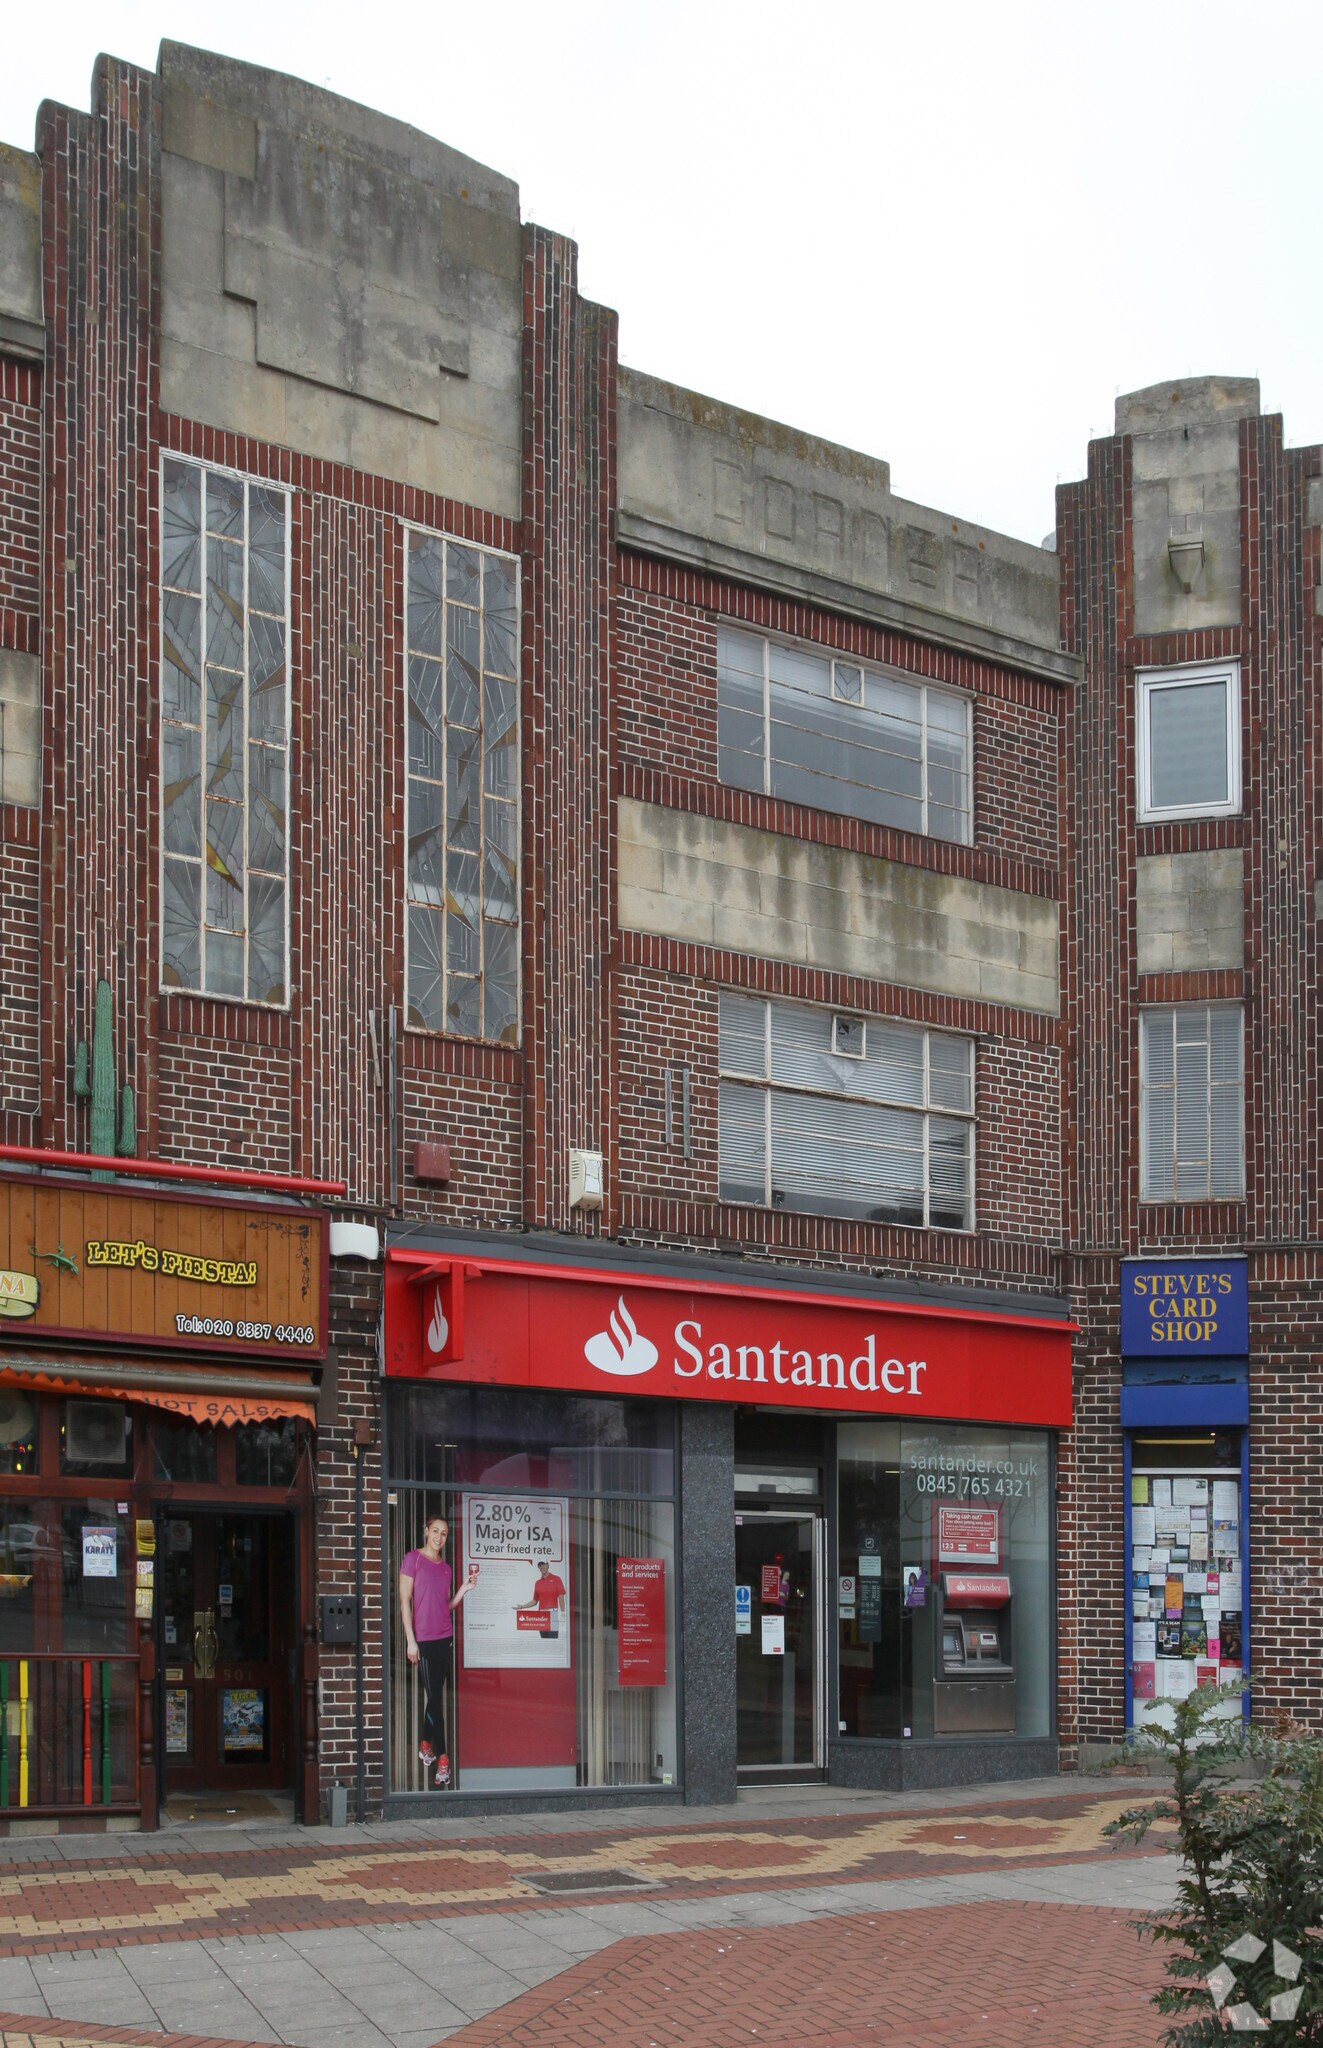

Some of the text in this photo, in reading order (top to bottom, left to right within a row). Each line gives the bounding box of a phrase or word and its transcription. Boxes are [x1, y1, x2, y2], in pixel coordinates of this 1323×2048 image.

[87, 1241, 257, 1285] LET'S FIESTA!
[1133, 1273, 1232, 1295] STEVE'S
[1149, 1298, 1217, 1318] CARD
[236, 1321, 272, 1339] 8337
[275, 1326, 314, 1343] 4446
[1151, 1321, 1218, 1341] SHOP
[674, 1320, 927, 1395] Santander
[206, 1403, 288, 1417] SALSA
[910, 1454, 1038, 1476] santander.co.uk
[917, 1474, 1031, 1497] 0845 765 4321
[475, 1503, 531, 1523] 2.80%
[945, 1512, 960, 1520] Taking
[476, 1524, 553, 1543] Major ISA
[85, 1546, 115, 1555] KARATE
[475, 1543, 555, 1555] 2 year fixed rate.
[967, 1582, 1001, 1592] Santander
